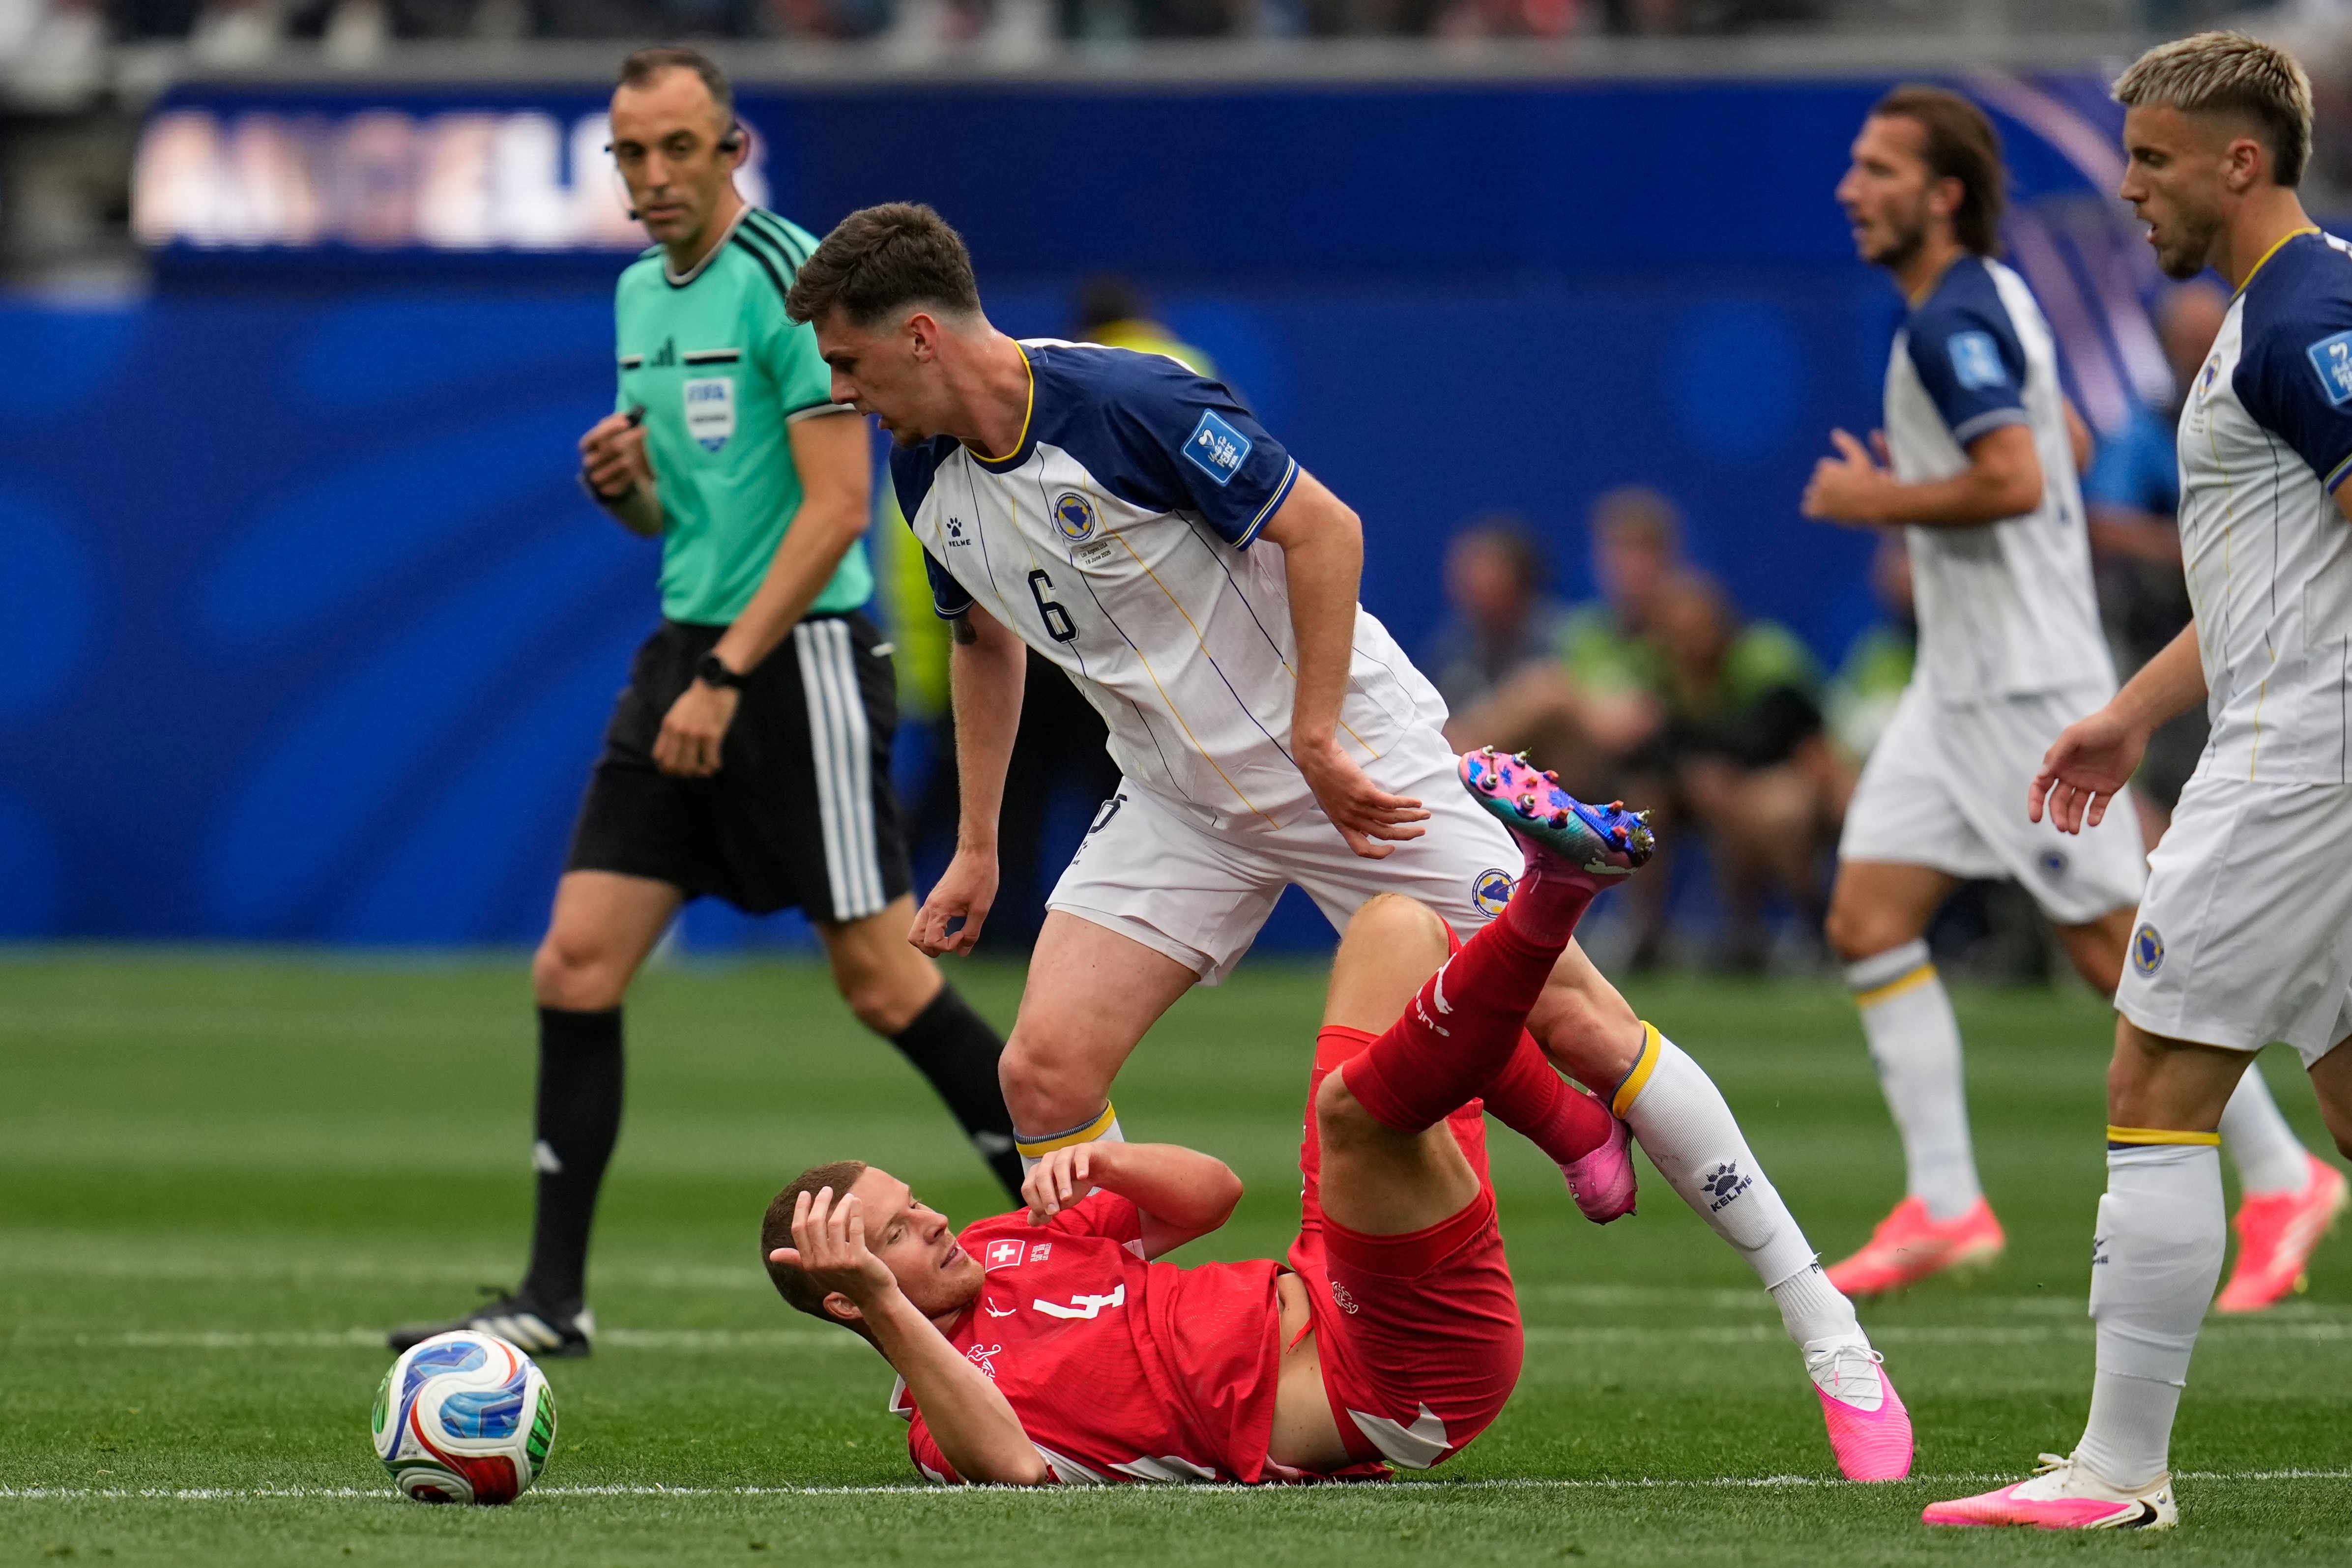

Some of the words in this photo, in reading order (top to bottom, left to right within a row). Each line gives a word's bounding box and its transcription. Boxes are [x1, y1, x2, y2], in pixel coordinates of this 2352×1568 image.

[1216, 442, 1236, 467] PEACE
[1229, 455, 1238, 467] FIFA
[948, 539, 971, 547] KELME
[1027, 568, 1079, 644] 6
[1711, 1174, 1753, 1213] KELME
[1033, 1283, 1125, 1319] 4
